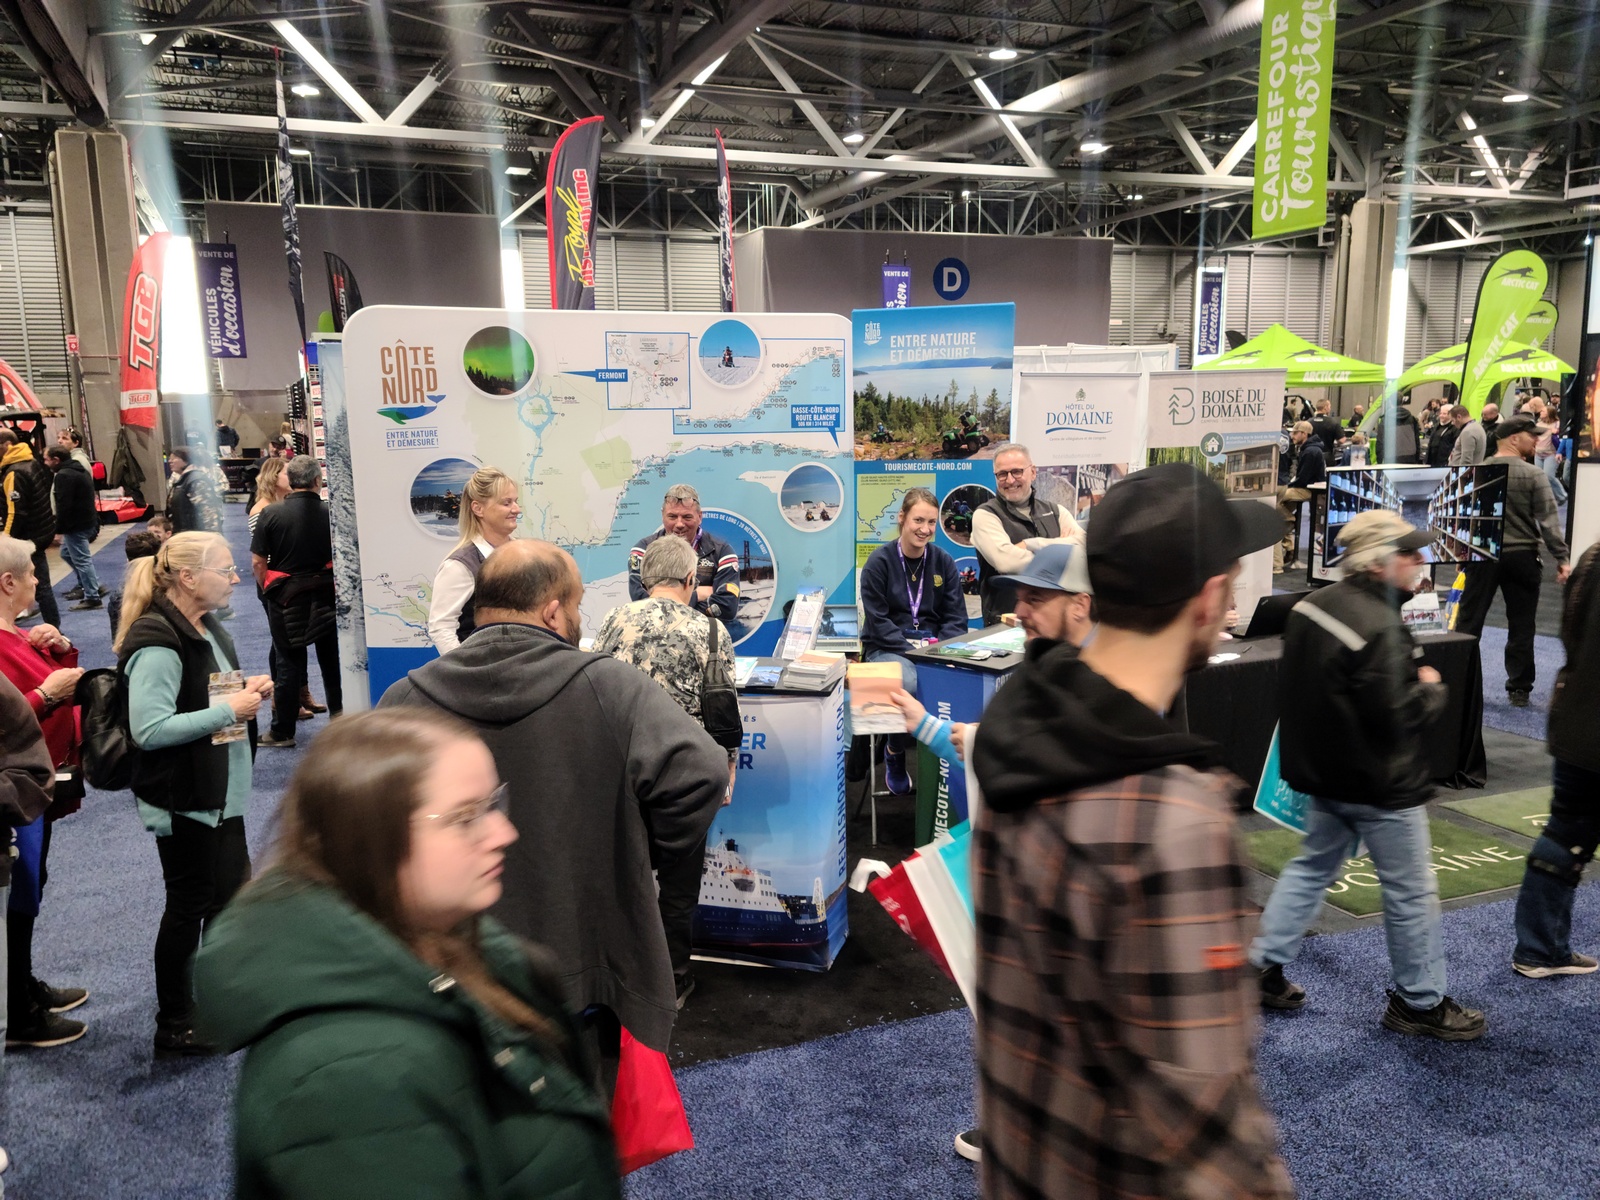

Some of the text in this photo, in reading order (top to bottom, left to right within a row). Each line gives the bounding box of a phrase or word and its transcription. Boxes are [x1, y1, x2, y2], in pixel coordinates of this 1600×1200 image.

[1260, 10, 1289, 223] CARREFOUR
[572, 167, 596, 288] DISBUTING
[198, 250, 234, 259] VENTE DE
[942, 266, 962, 292] D
[1501, 278, 1539, 291] ARCTIC CAT
[219, 264, 242, 357] d'occasion
[129, 272, 159, 371] TGB
[205, 287, 223, 355] VÉHICULES
[1199, 303, 1209, 353] VÉHICULES
[1208, 287, 1221, 354] d'occasion
[890, 332, 976, 348] ENTRE NATURE
[1472, 310, 1520, 380] ARCTIC CAT
[380, 339, 435, 375] CÔTE
[890, 350, 902, 362] ET
[907, 347, 970, 361] DÉMESURE
[1454, 363, 1464, 374] CA
[1501, 360, 1559, 373] ARCTIC CAT
[598, 371, 626, 379] FERMONT
[1303, 371, 1352, 383] ARCTIC CAT
[382, 367, 438, 405] NORD
[128, 393, 152, 404] TGB
[1202, 387, 1267, 404] BOISÉ DU
[792, 404, 840, 414] BASSE-CÔTE-NORD
[813, 413, 836, 421] BLANCHE
[1201, 403, 1266, 419] DOMAINE
[1046, 411, 1113, 426] DOMAINE
[386, 429, 438, 439] ENTRE NATURE
[387, 440, 395, 448] ET
[397, 438, 434, 447] DÉMESURE
[884, 462, 972, 472] TOURISMECOTE-NORD.COM
[725, 516, 737, 525] LONG
[744, 524, 758, 541] MÈTRES
[836, 700, 847, 877] RELAISNORDIK.COM
